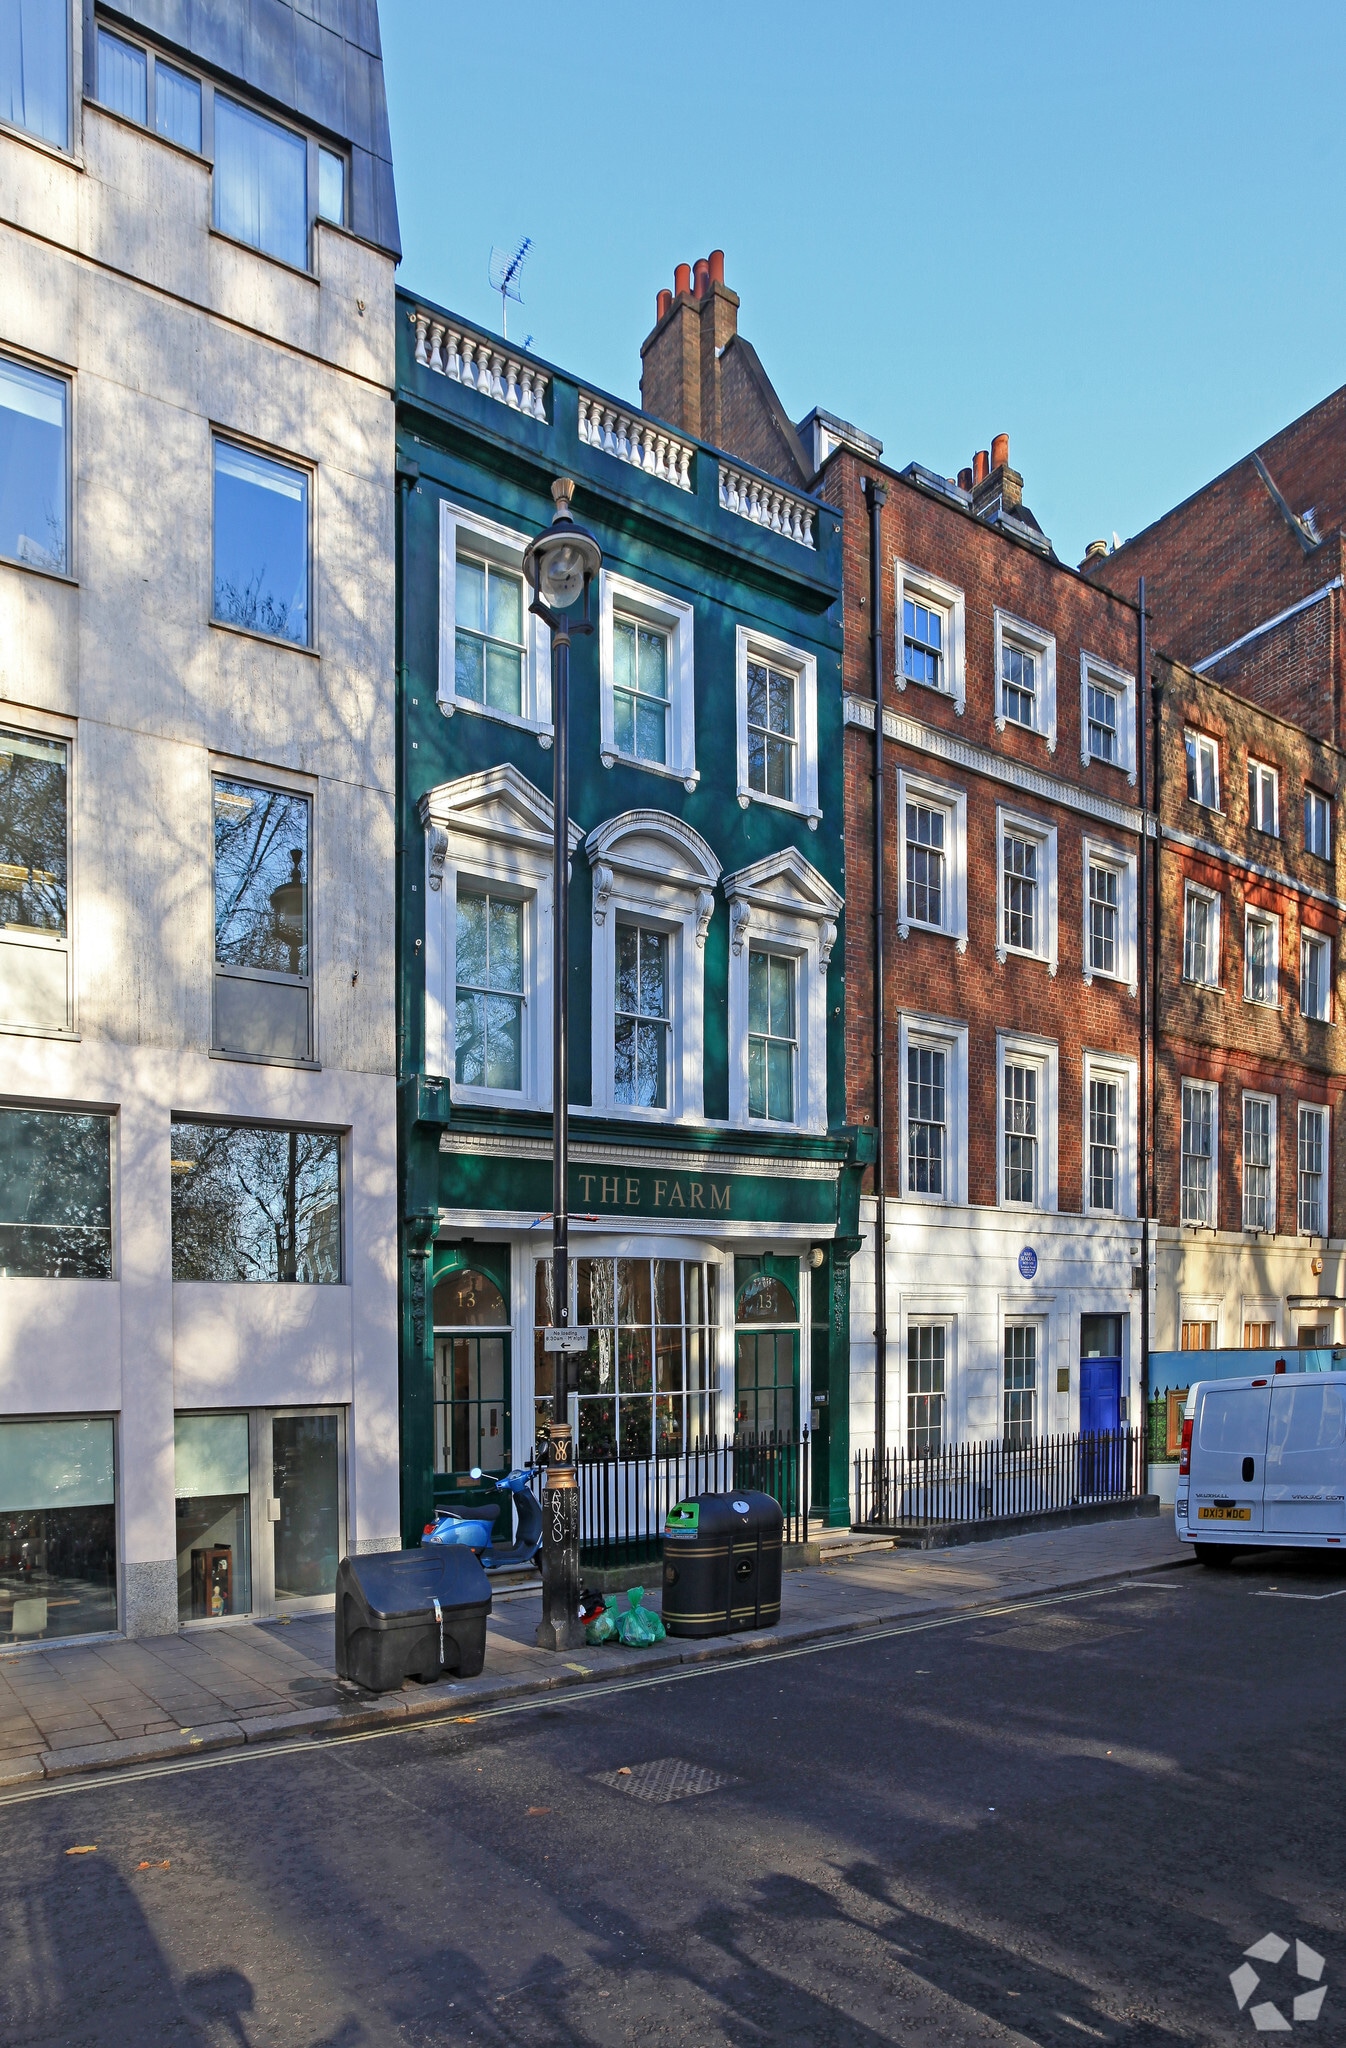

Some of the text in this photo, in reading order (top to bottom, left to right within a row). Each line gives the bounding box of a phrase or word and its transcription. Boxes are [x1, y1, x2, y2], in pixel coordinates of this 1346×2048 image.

[578, 1174, 732, 1211] THE FARM
[457, 1291, 476, 1308] 13
[759, 1294, 772, 1309] 13
[562, 1308, 568, 1317] 6
[1203, 1508, 1245, 1519] DX13 WDC
